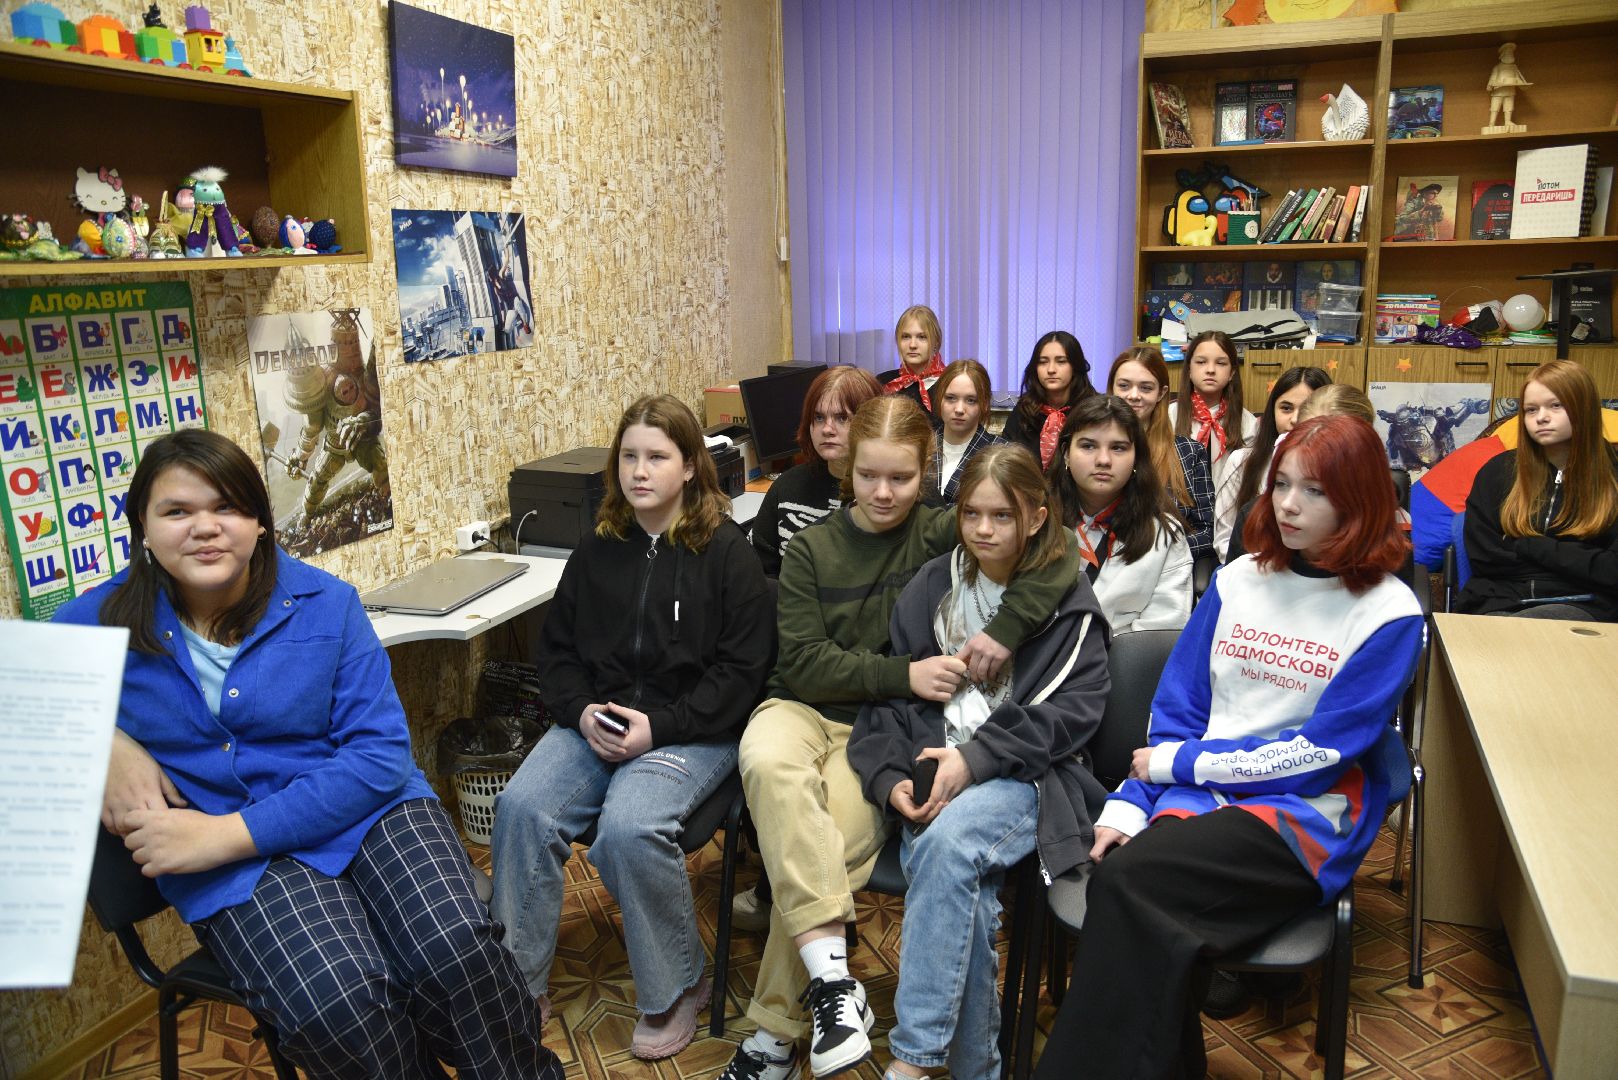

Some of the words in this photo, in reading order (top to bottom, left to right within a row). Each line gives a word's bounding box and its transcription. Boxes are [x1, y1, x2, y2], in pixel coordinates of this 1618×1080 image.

[1522, 191, 1574, 203] ПЕРЕДАРИШЬ
[1537, 181, 1560, 190] ПОТОМ
[29, 288, 147, 314] АЛФАВИТ
[32, 324, 58, 353] Б
[78, 320, 104, 349] В
[121, 317, 140, 345] Г
[162, 314, 184, 345] Д
[254, 343, 339, 374] DEMIGOD
[41, 364, 66, 398] Ё
[84, 363, 115, 393] Ж
[168, 355, 191, 382] И
[0, 416, 32, 452] Й
[50, 413, 76, 444] К
[95, 407, 119, 436] Л
[135, 401, 162, 429] М
[175, 395, 197, 422] Н
[9, 467, 39, 496] О
[58, 457, 87, 488] П
[102, 450, 123, 479] Р
[18, 511, 43, 543] У
[67, 502, 95, 529] Ф
[25, 554, 57, 588] Ш
[1241, 667, 1261, 680] МЫ
[1263, 672, 1308, 693] РЯДОМ
[1211, 739, 1313, 766] ОДМОСКОВЬЯ
[1231, 749, 1328, 778] ВОЛОНТЕРЫ
